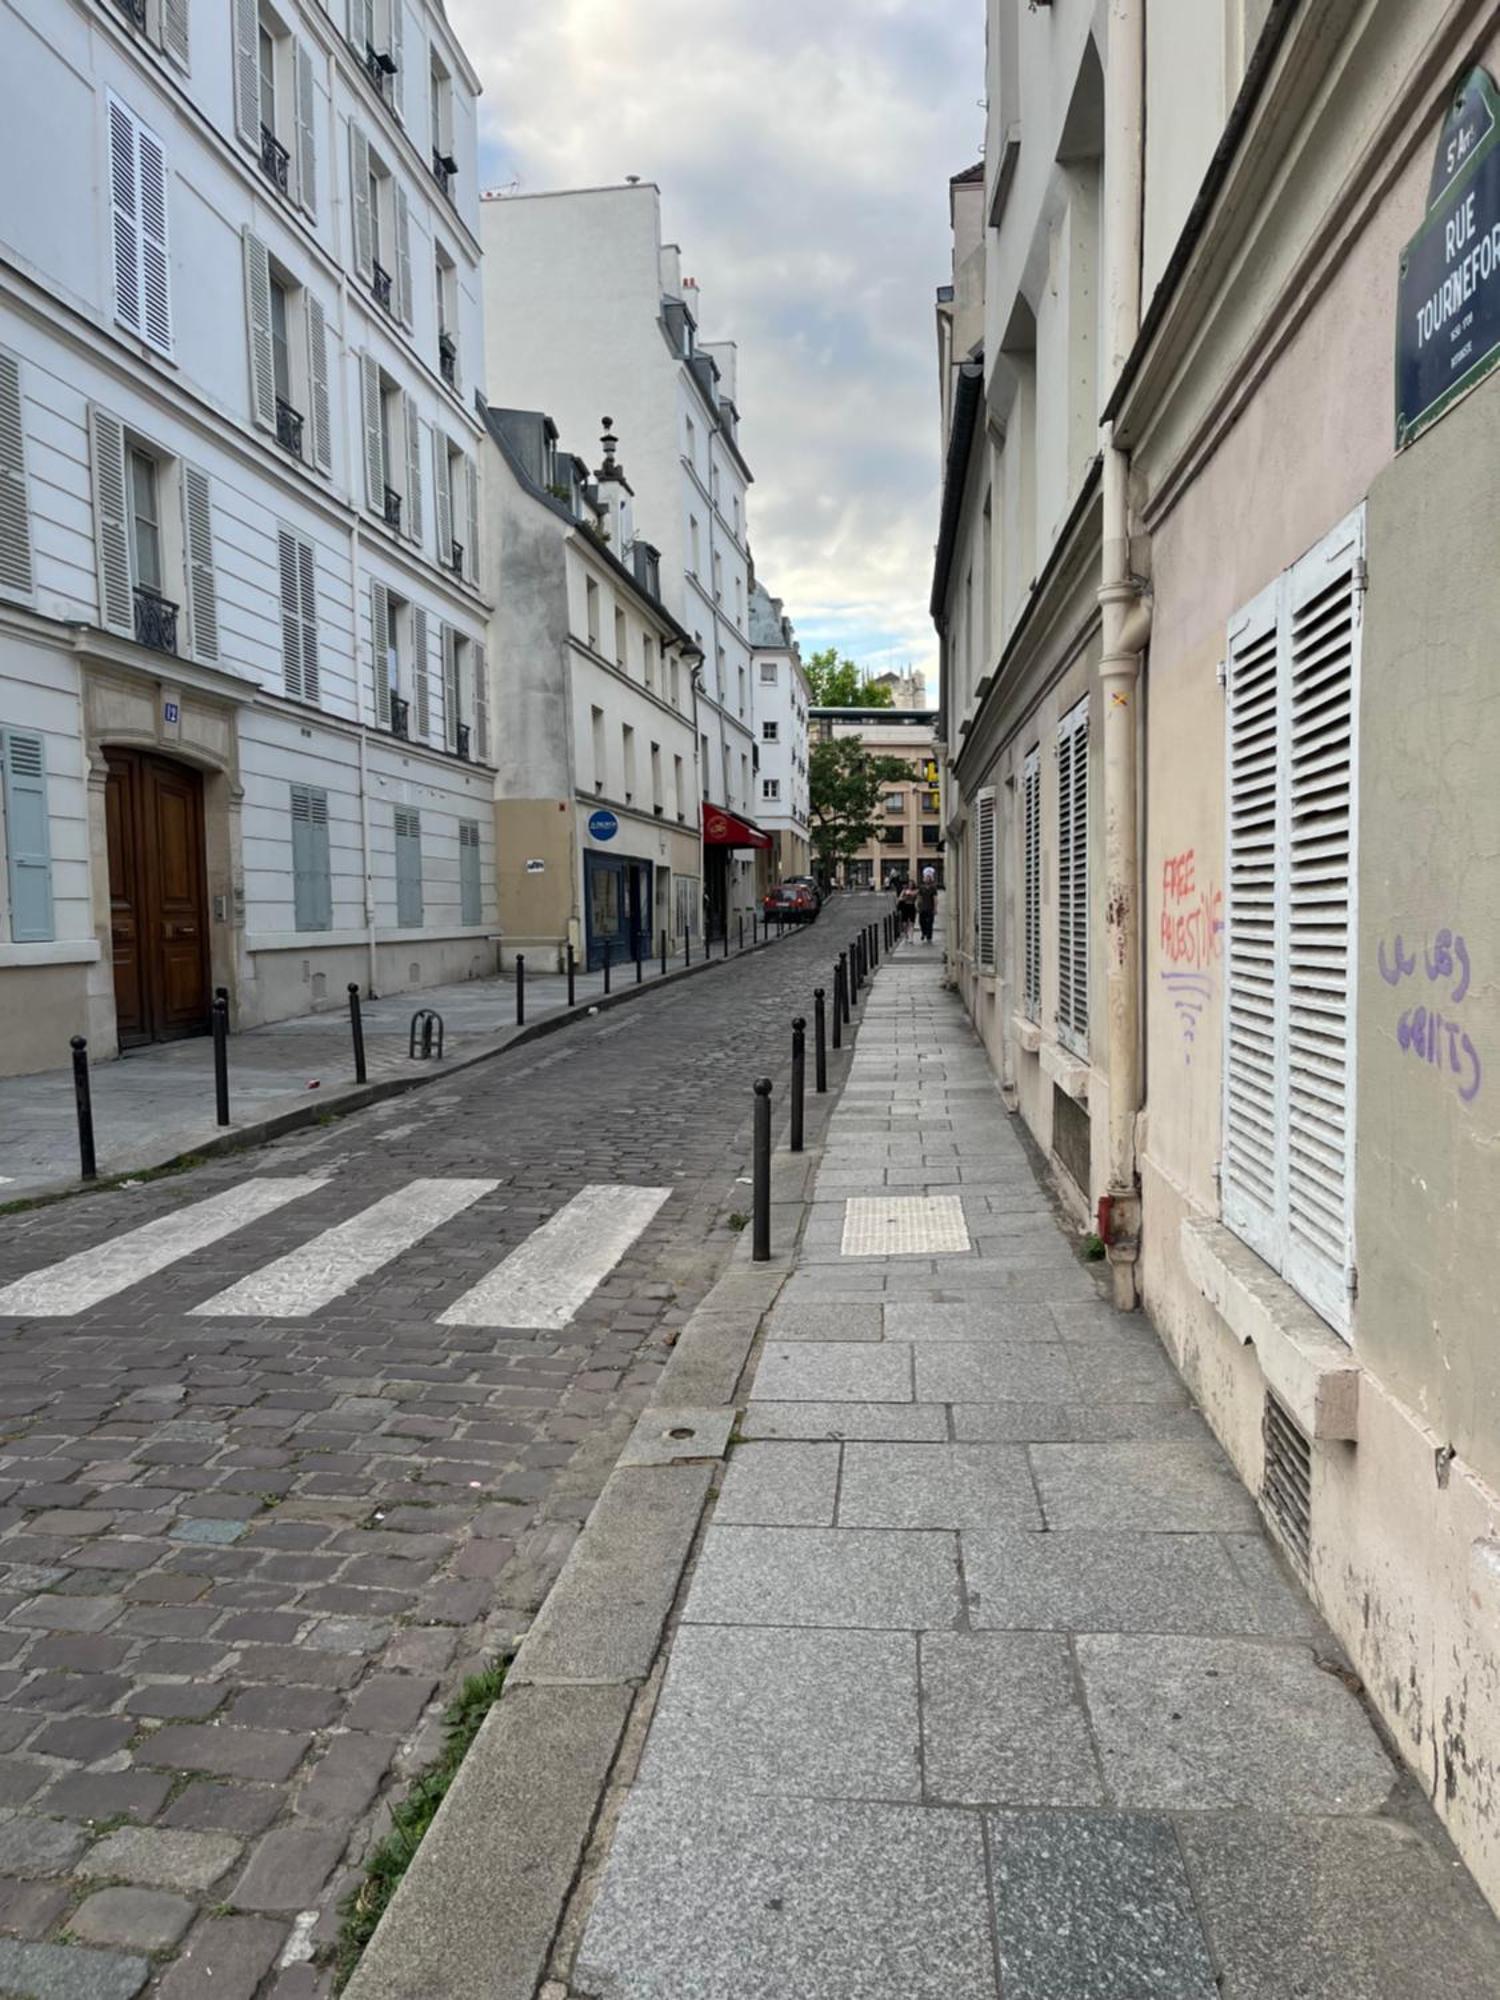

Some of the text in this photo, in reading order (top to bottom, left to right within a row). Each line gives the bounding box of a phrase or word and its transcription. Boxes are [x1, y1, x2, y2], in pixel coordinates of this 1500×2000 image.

[1445, 191, 1476, 264] RUE
[1416, 222, 1500, 349] TOURNEFOR
[167, 703, 177, 721] 12
[1162, 847, 1196, 908] FREE
